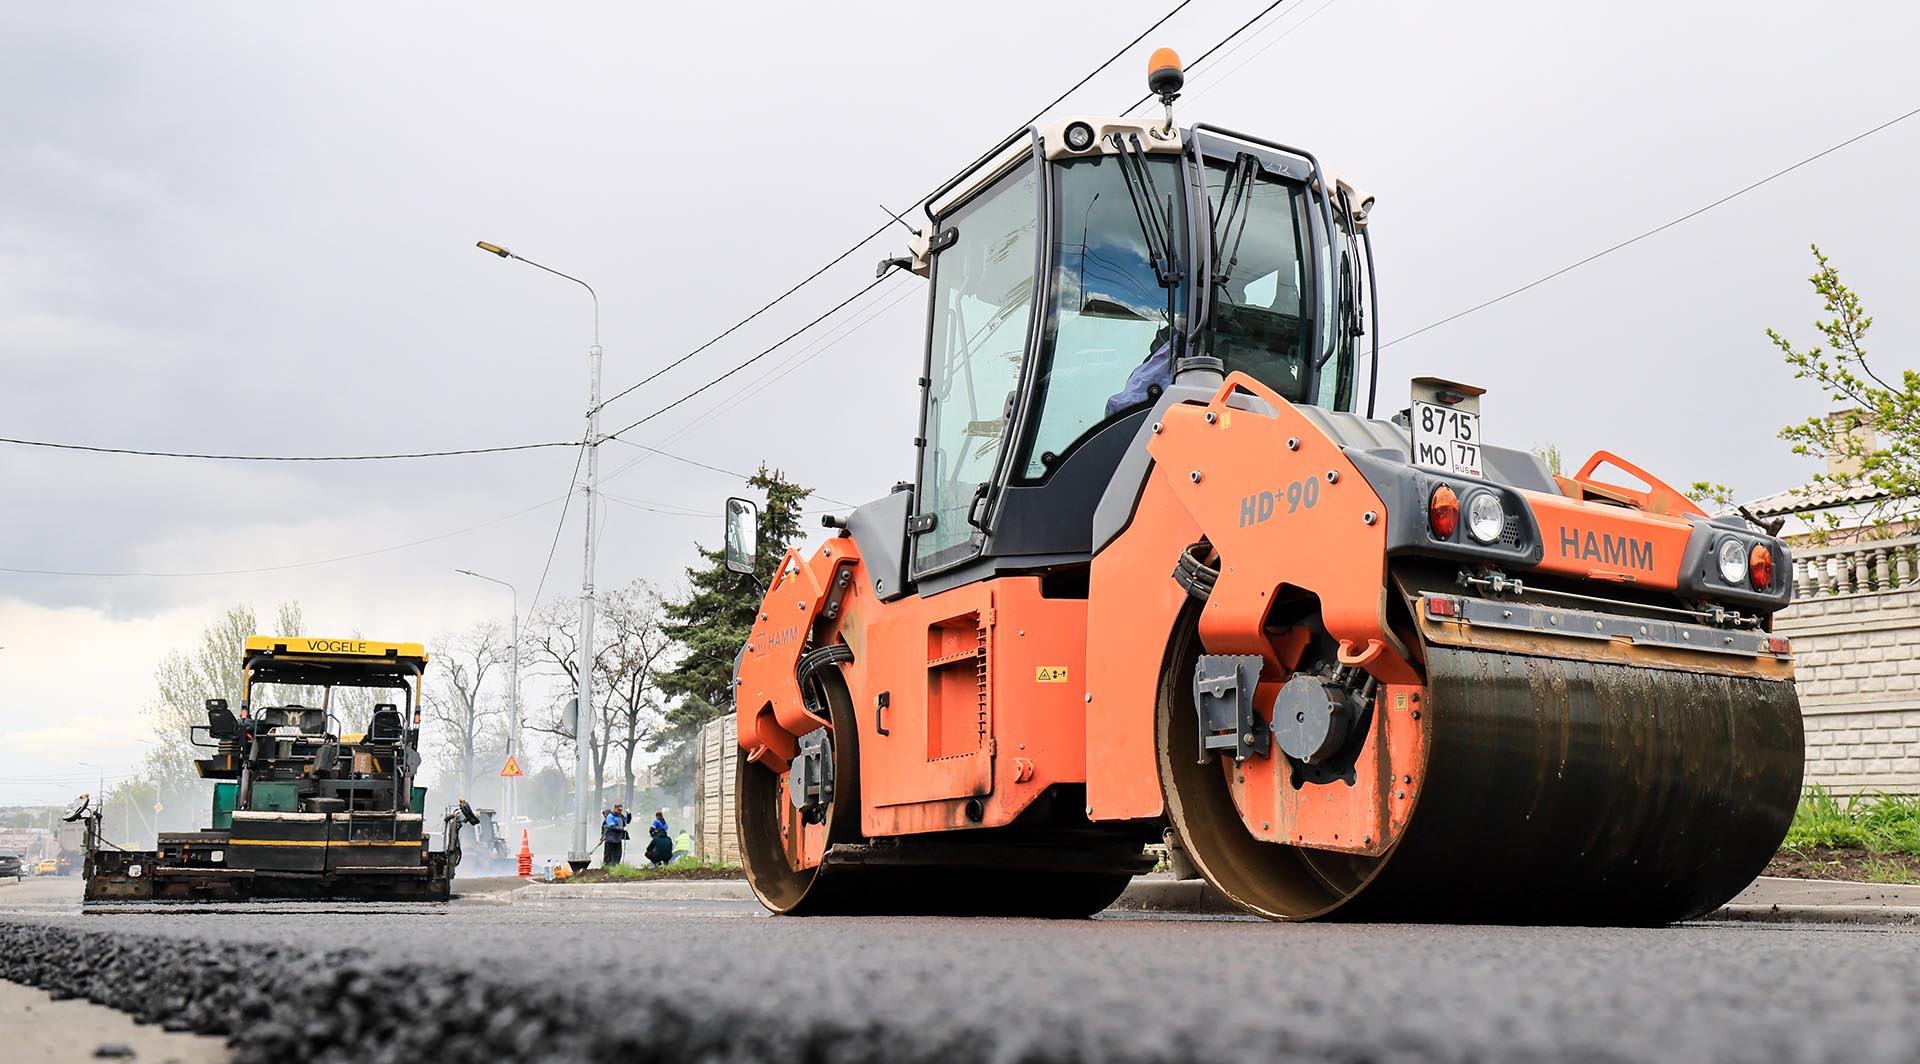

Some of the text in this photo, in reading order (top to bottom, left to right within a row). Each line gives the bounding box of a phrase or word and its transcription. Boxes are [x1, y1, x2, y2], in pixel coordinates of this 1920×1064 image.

[1422, 406, 1472, 441] 8715
[1457, 444, 1476, 467] 77
[1455, 464, 1470, 474] RUS
[1560, 526, 1654, 572] HAMM
[768, 626, 798, 648] HAMM
